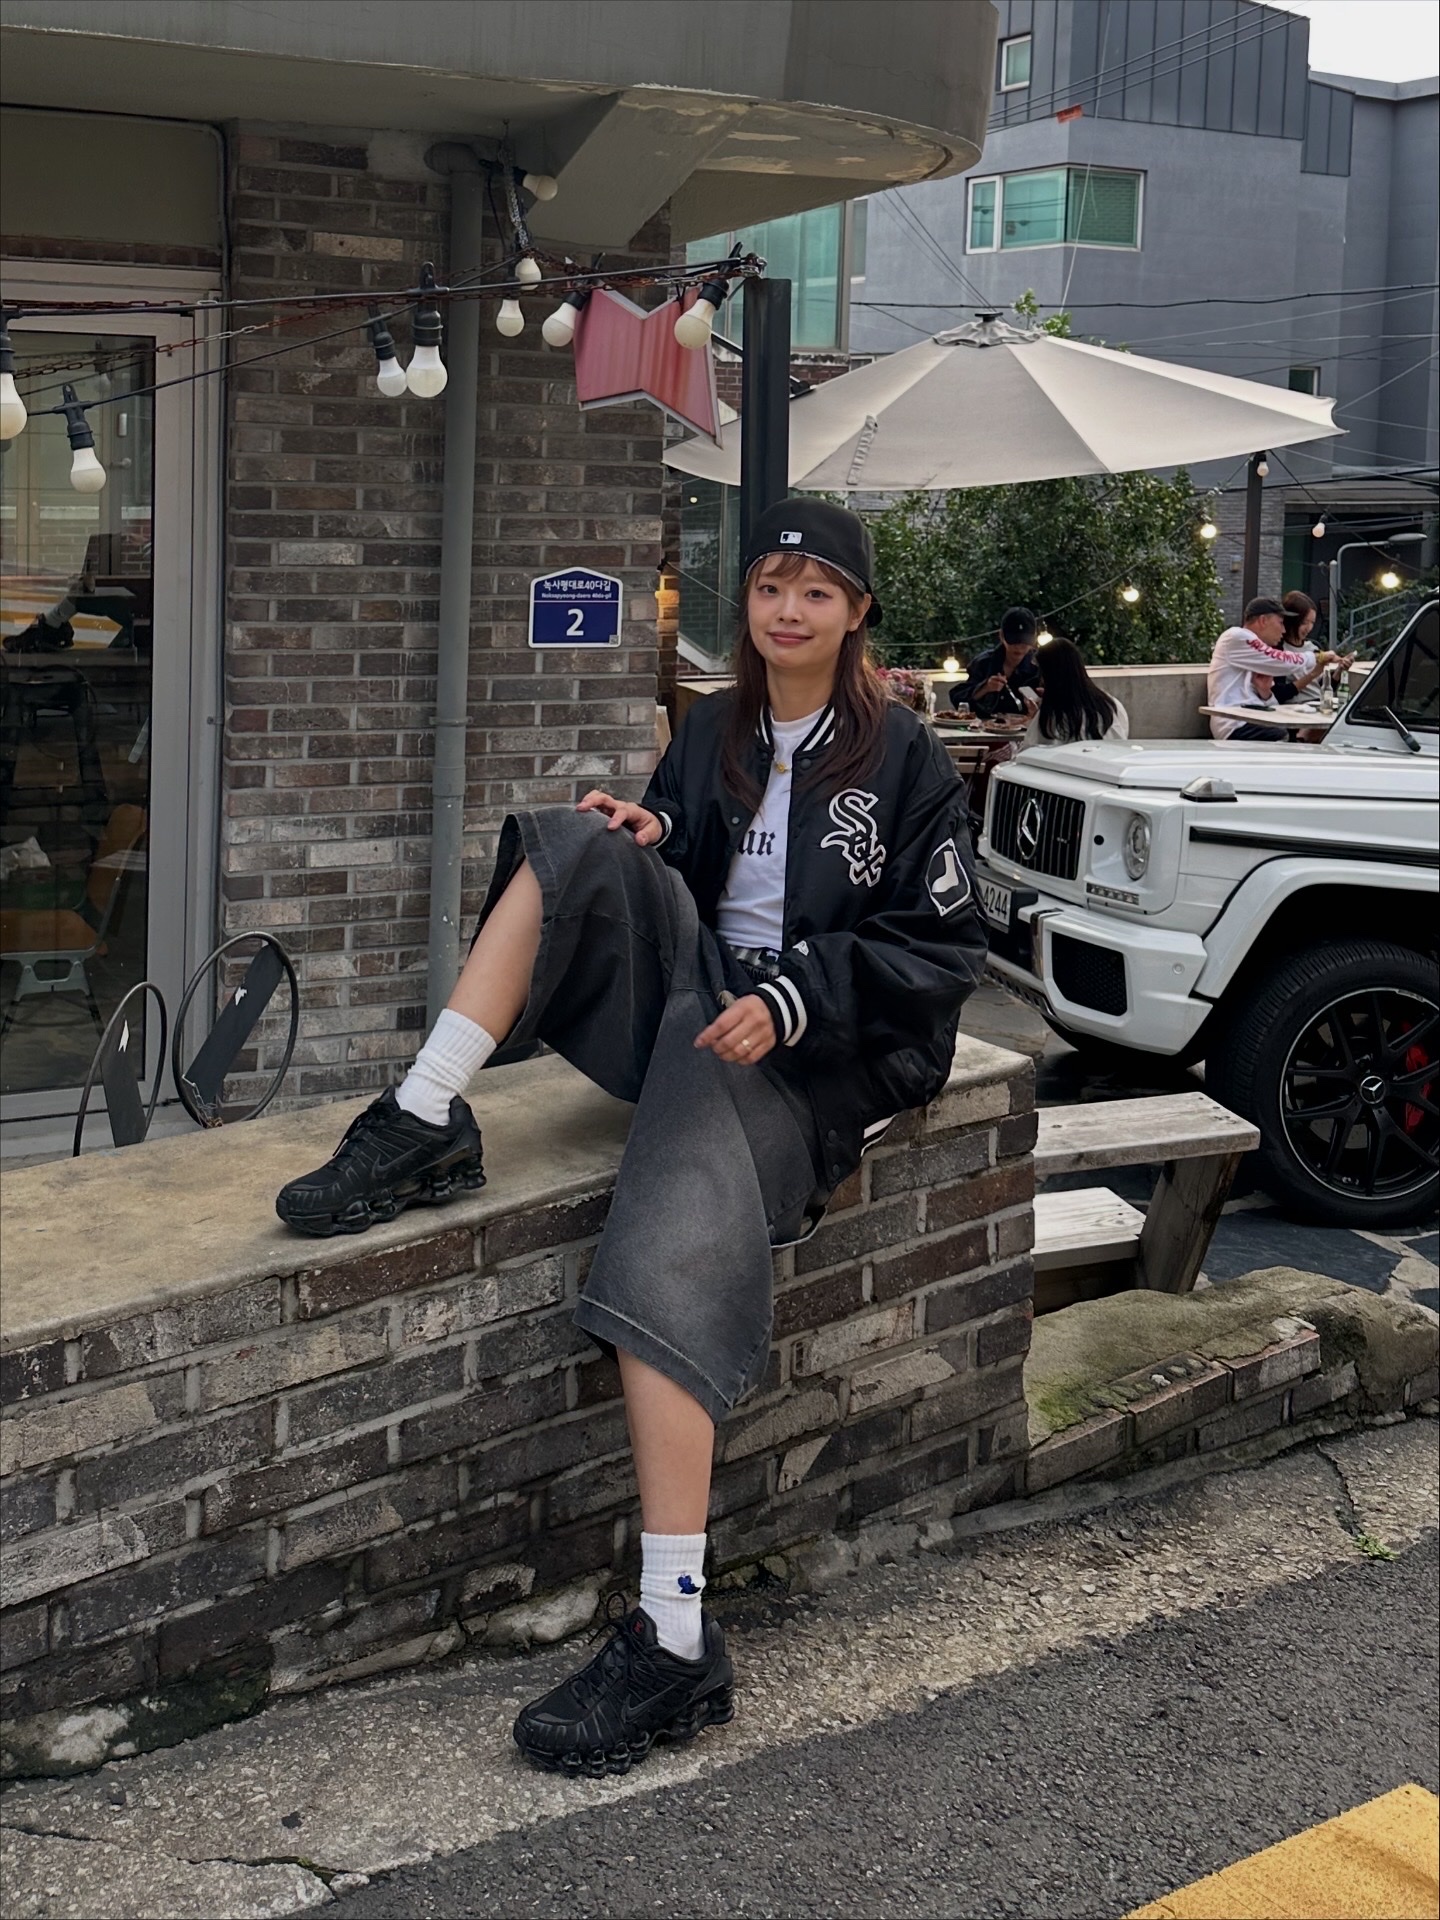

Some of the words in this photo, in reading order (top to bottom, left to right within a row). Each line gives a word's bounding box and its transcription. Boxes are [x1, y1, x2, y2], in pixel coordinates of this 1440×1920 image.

[543, 580, 611, 591] 녹사평대로40다길
[566, 608, 584, 636] 2
[983, 885, 1008, 919] 4244
